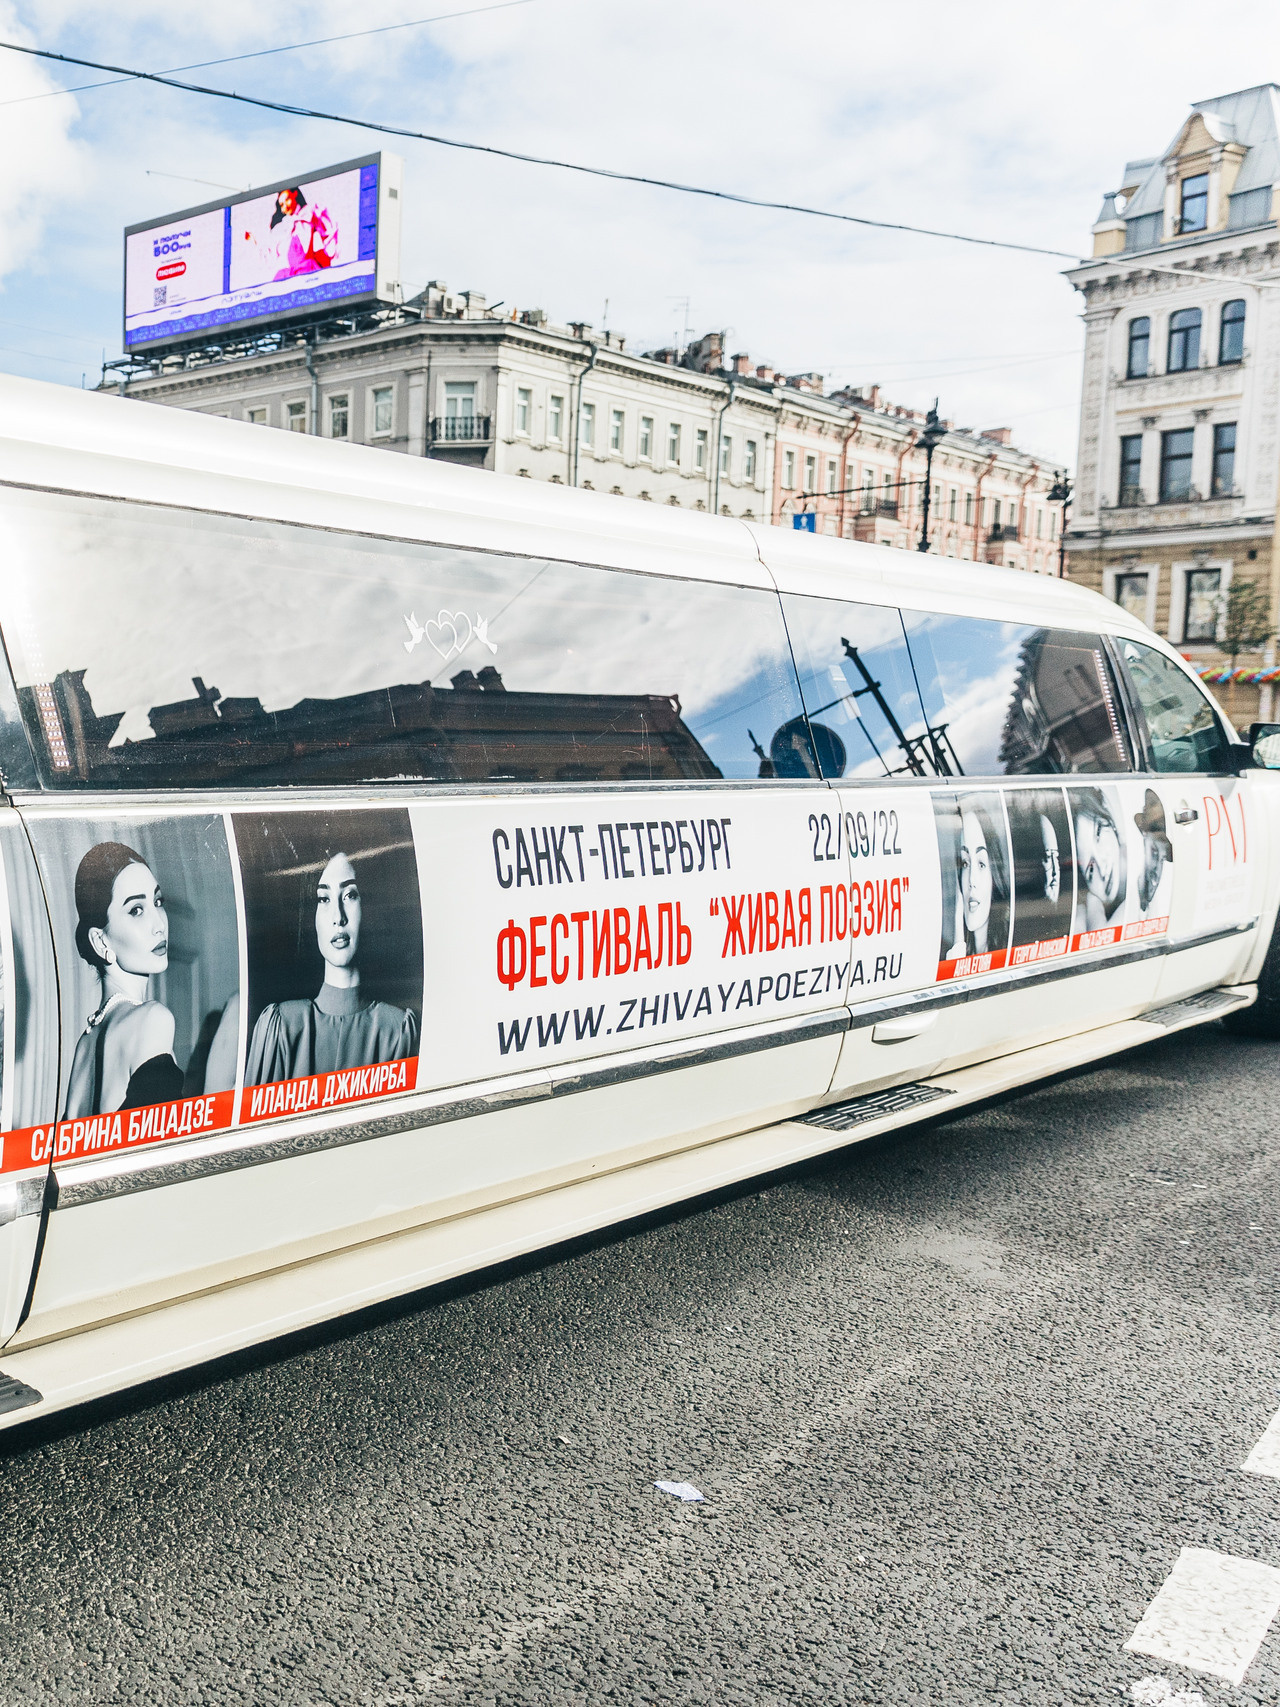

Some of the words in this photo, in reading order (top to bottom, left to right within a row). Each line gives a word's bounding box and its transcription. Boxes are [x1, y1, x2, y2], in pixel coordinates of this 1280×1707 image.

[492, 818, 732, 889] САНКТ-ПЕТЕРБУРГ
[808, 809, 902, 862] 22/09/22
[496, 900, 692, 992] ФЕСТИВАЛЬ
[497, 953, 903, 1056] WWW.ZHIVAYAPOEZIYA.RU
[30, 1114, 122, 1162] САБРИНА
[127, 1096, 216, 1143] БИЦАДЗЕ
[250, 1078, 318, 1117] ИЛАНДА
[322, 1061, 407, 1106] ДЖИКИРБА
